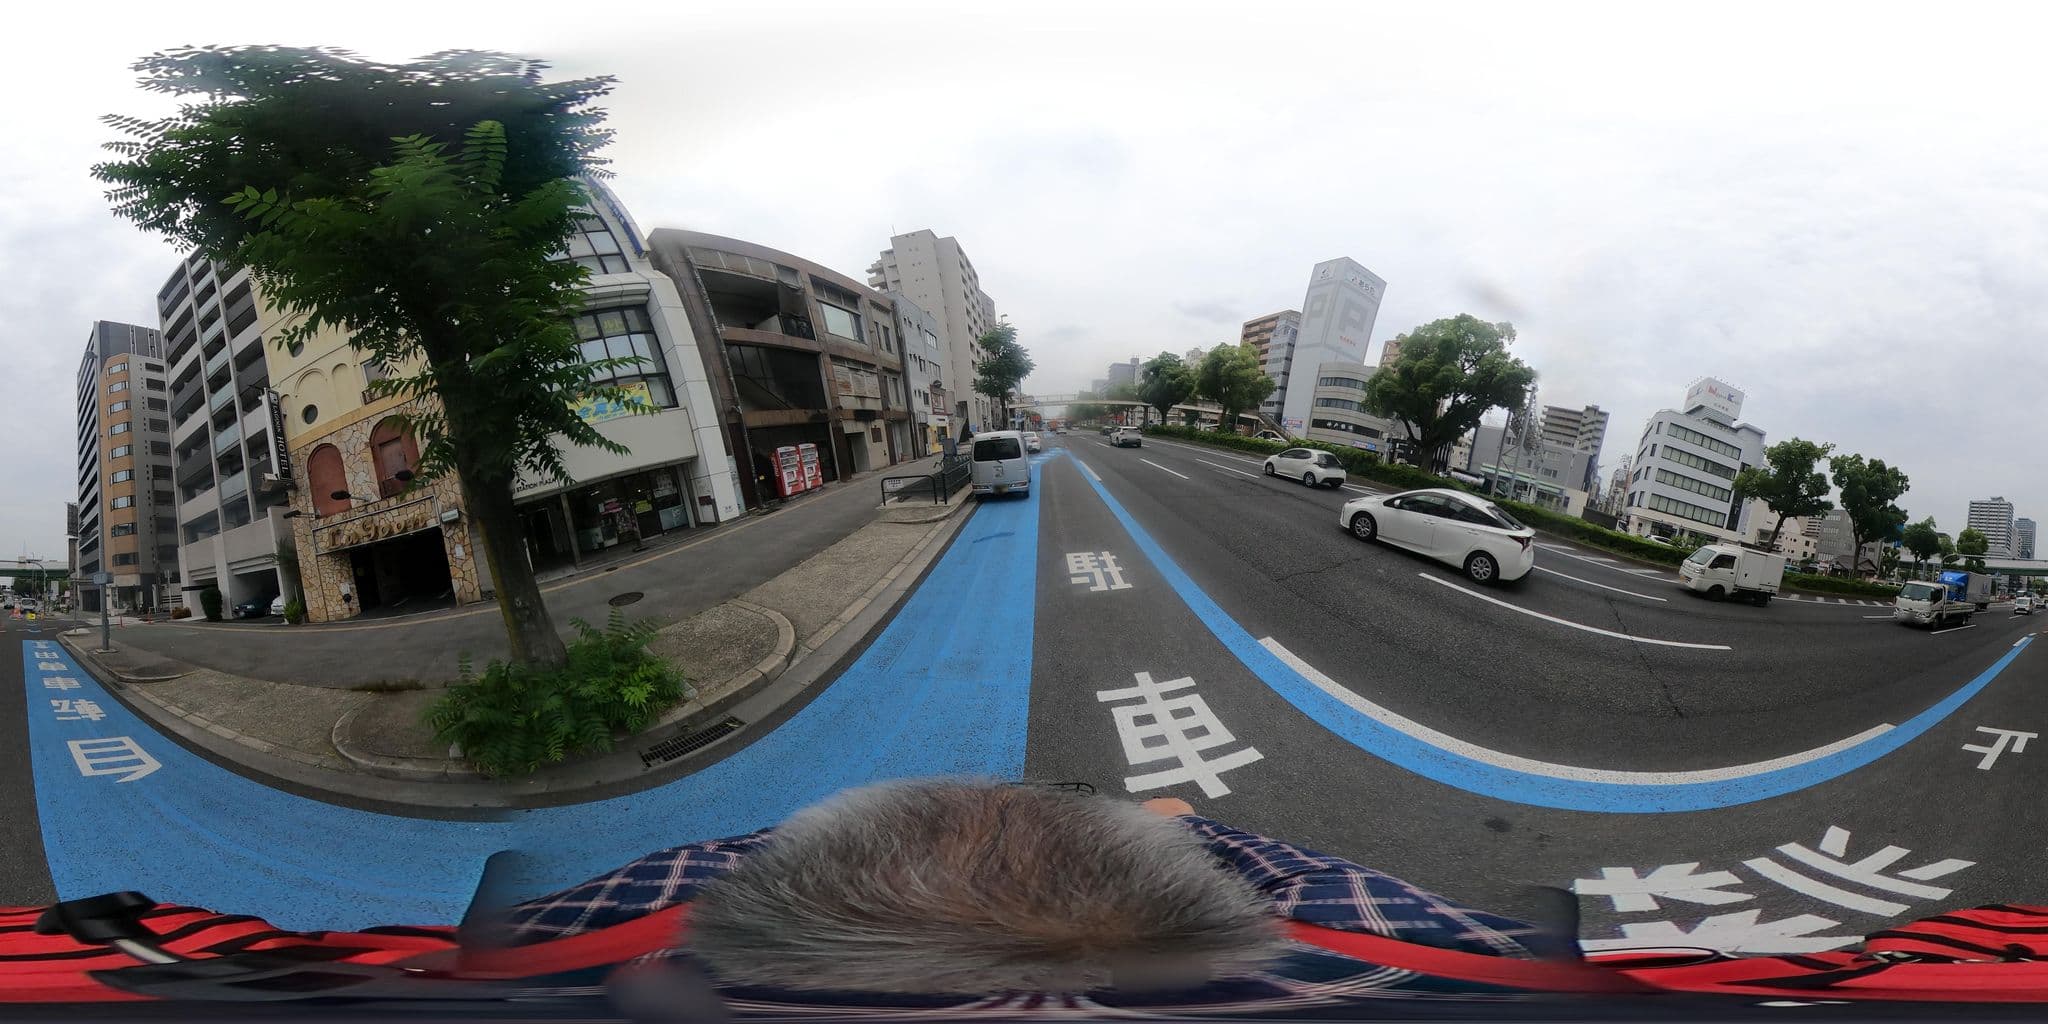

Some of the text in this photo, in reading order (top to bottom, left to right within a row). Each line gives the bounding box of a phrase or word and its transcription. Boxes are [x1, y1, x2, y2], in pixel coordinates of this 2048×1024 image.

[276, 435, 289, 476] HOTEL
[1065, 550, 1134, 592] 駐
[1096, 671, 1265, 800] 車
[1961, 725, 2039, 771] 止
